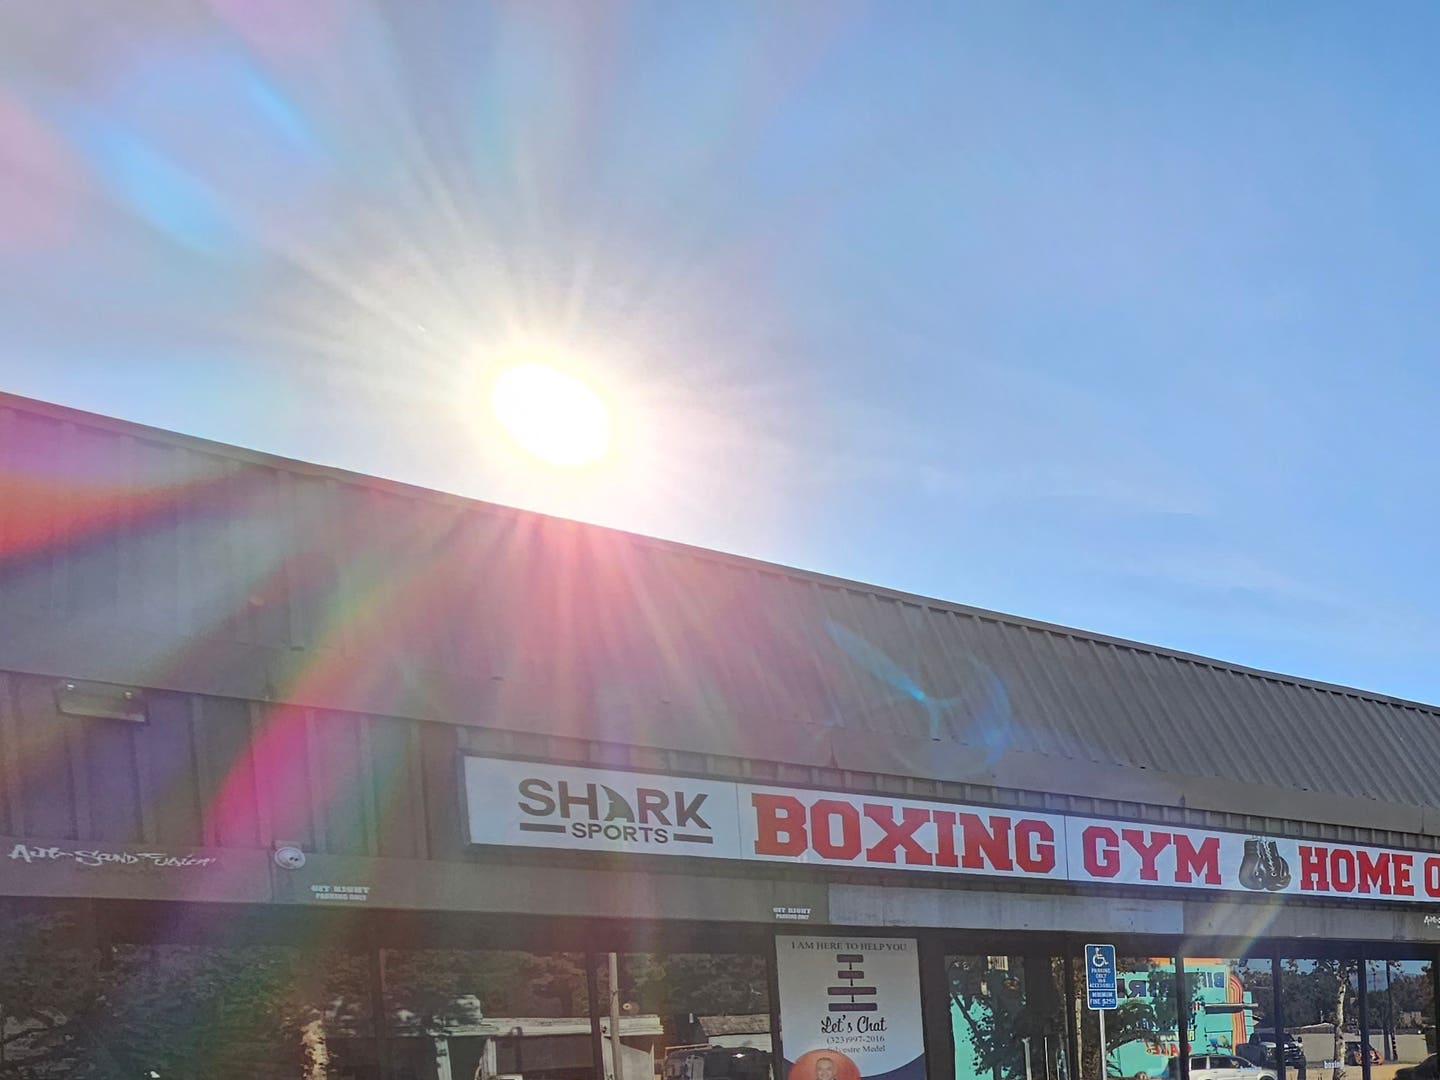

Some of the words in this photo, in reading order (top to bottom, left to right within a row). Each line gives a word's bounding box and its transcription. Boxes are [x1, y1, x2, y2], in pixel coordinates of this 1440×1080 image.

[518, 778, 712, 830] SHARK
[571, 822, 668, 844] SPORTS
[751, 792, 1056, 874] BOXING
[1082, 824, 1222, 886] GYM
[1298, 845, 1416, 899] HOME
[817, 942, 842, 950] HERE
[857, 1015, 888, 1033] Chat
